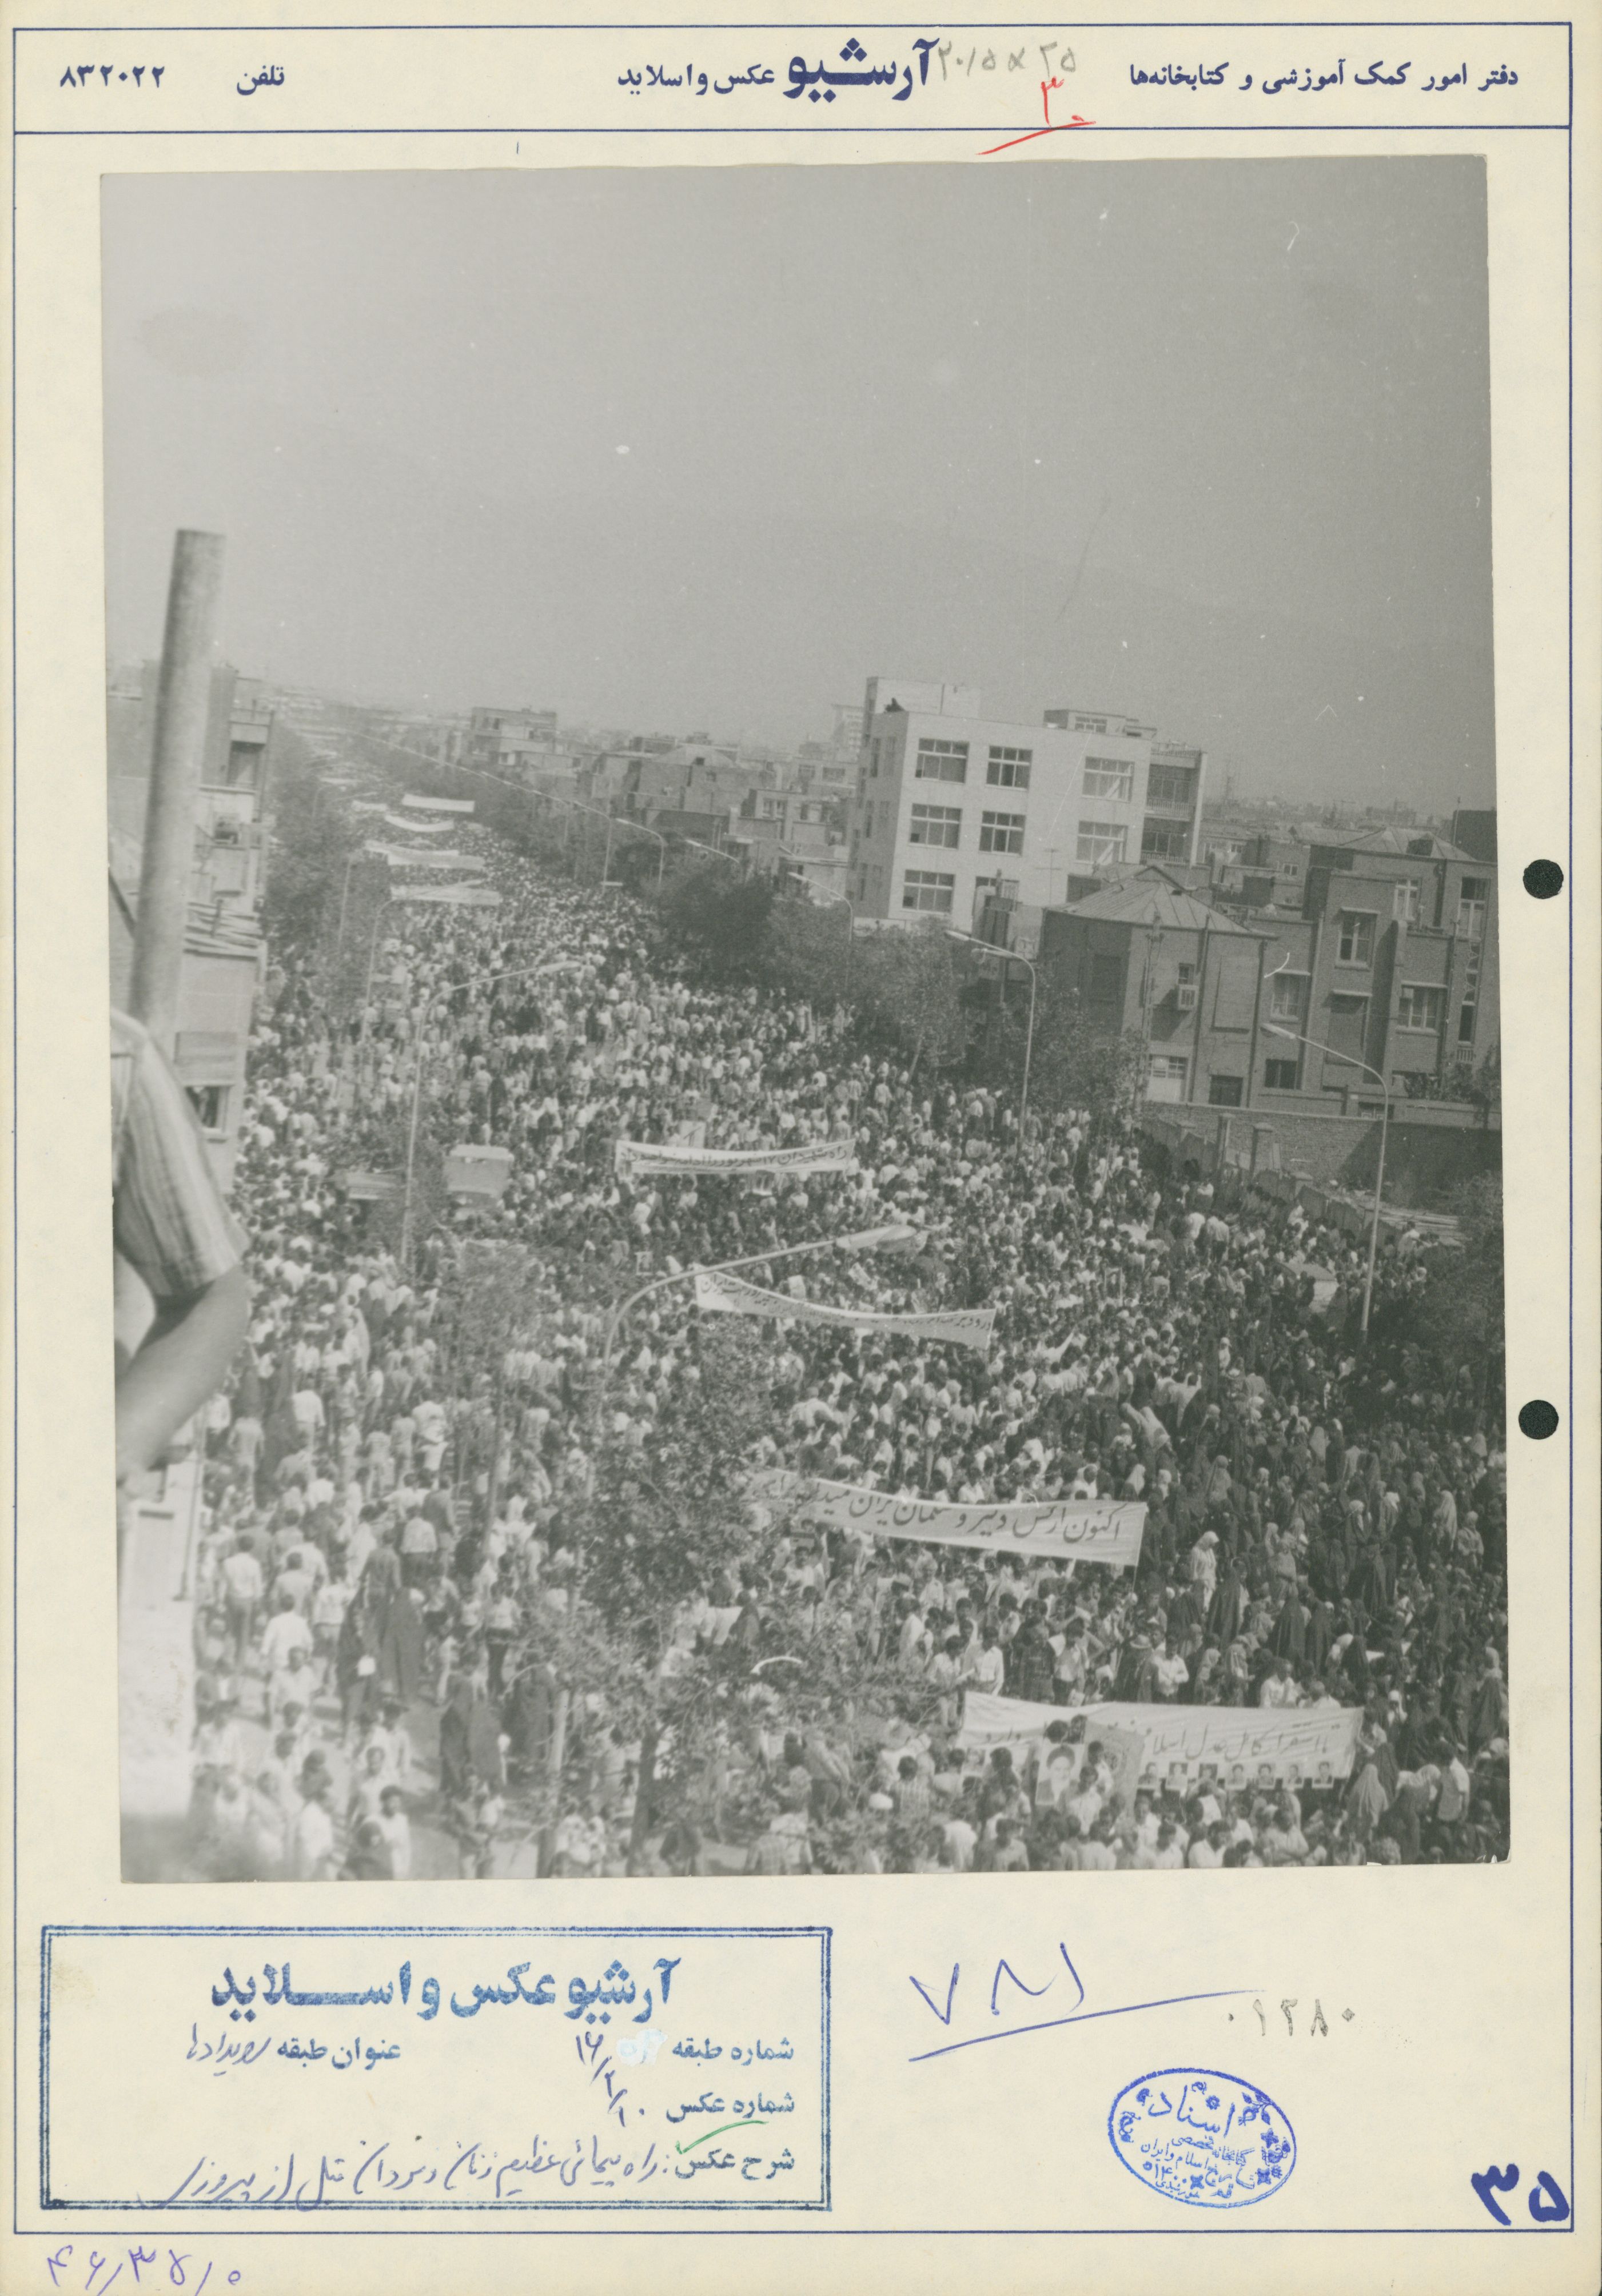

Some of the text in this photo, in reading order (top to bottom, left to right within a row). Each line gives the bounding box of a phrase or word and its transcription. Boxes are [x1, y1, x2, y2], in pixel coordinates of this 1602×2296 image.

[59, 64, 285, 96] تلفن ۸۳۲۰۲۲
[617, 37, 942, 103] آرشیو عکس و اسلاید
[1238, 74, 1253, 91] و
[1262, 58, 1346, 95] آموزشی
[1354, 60, 1412, 86] کمک
[1420, 62, 1468, 91] امور
[1477, 63, 1519, 92] دفتر
[1063, 1502, 1128, 1544] اکنون
[211, 1957, 682, 2025] آرشیو عکس و اسلاید
[277, 2035, 402, 2072] عنوان طبقه
[672, 2036, 724, 2068] طبقه
[730, 2035, 796, 2067] شماره
[665, 2090, 796, 2123] شماره عکس
[740, 2147, 796, 2181] شرح
[1469, 2161, 1571, 2227] ۳۵
